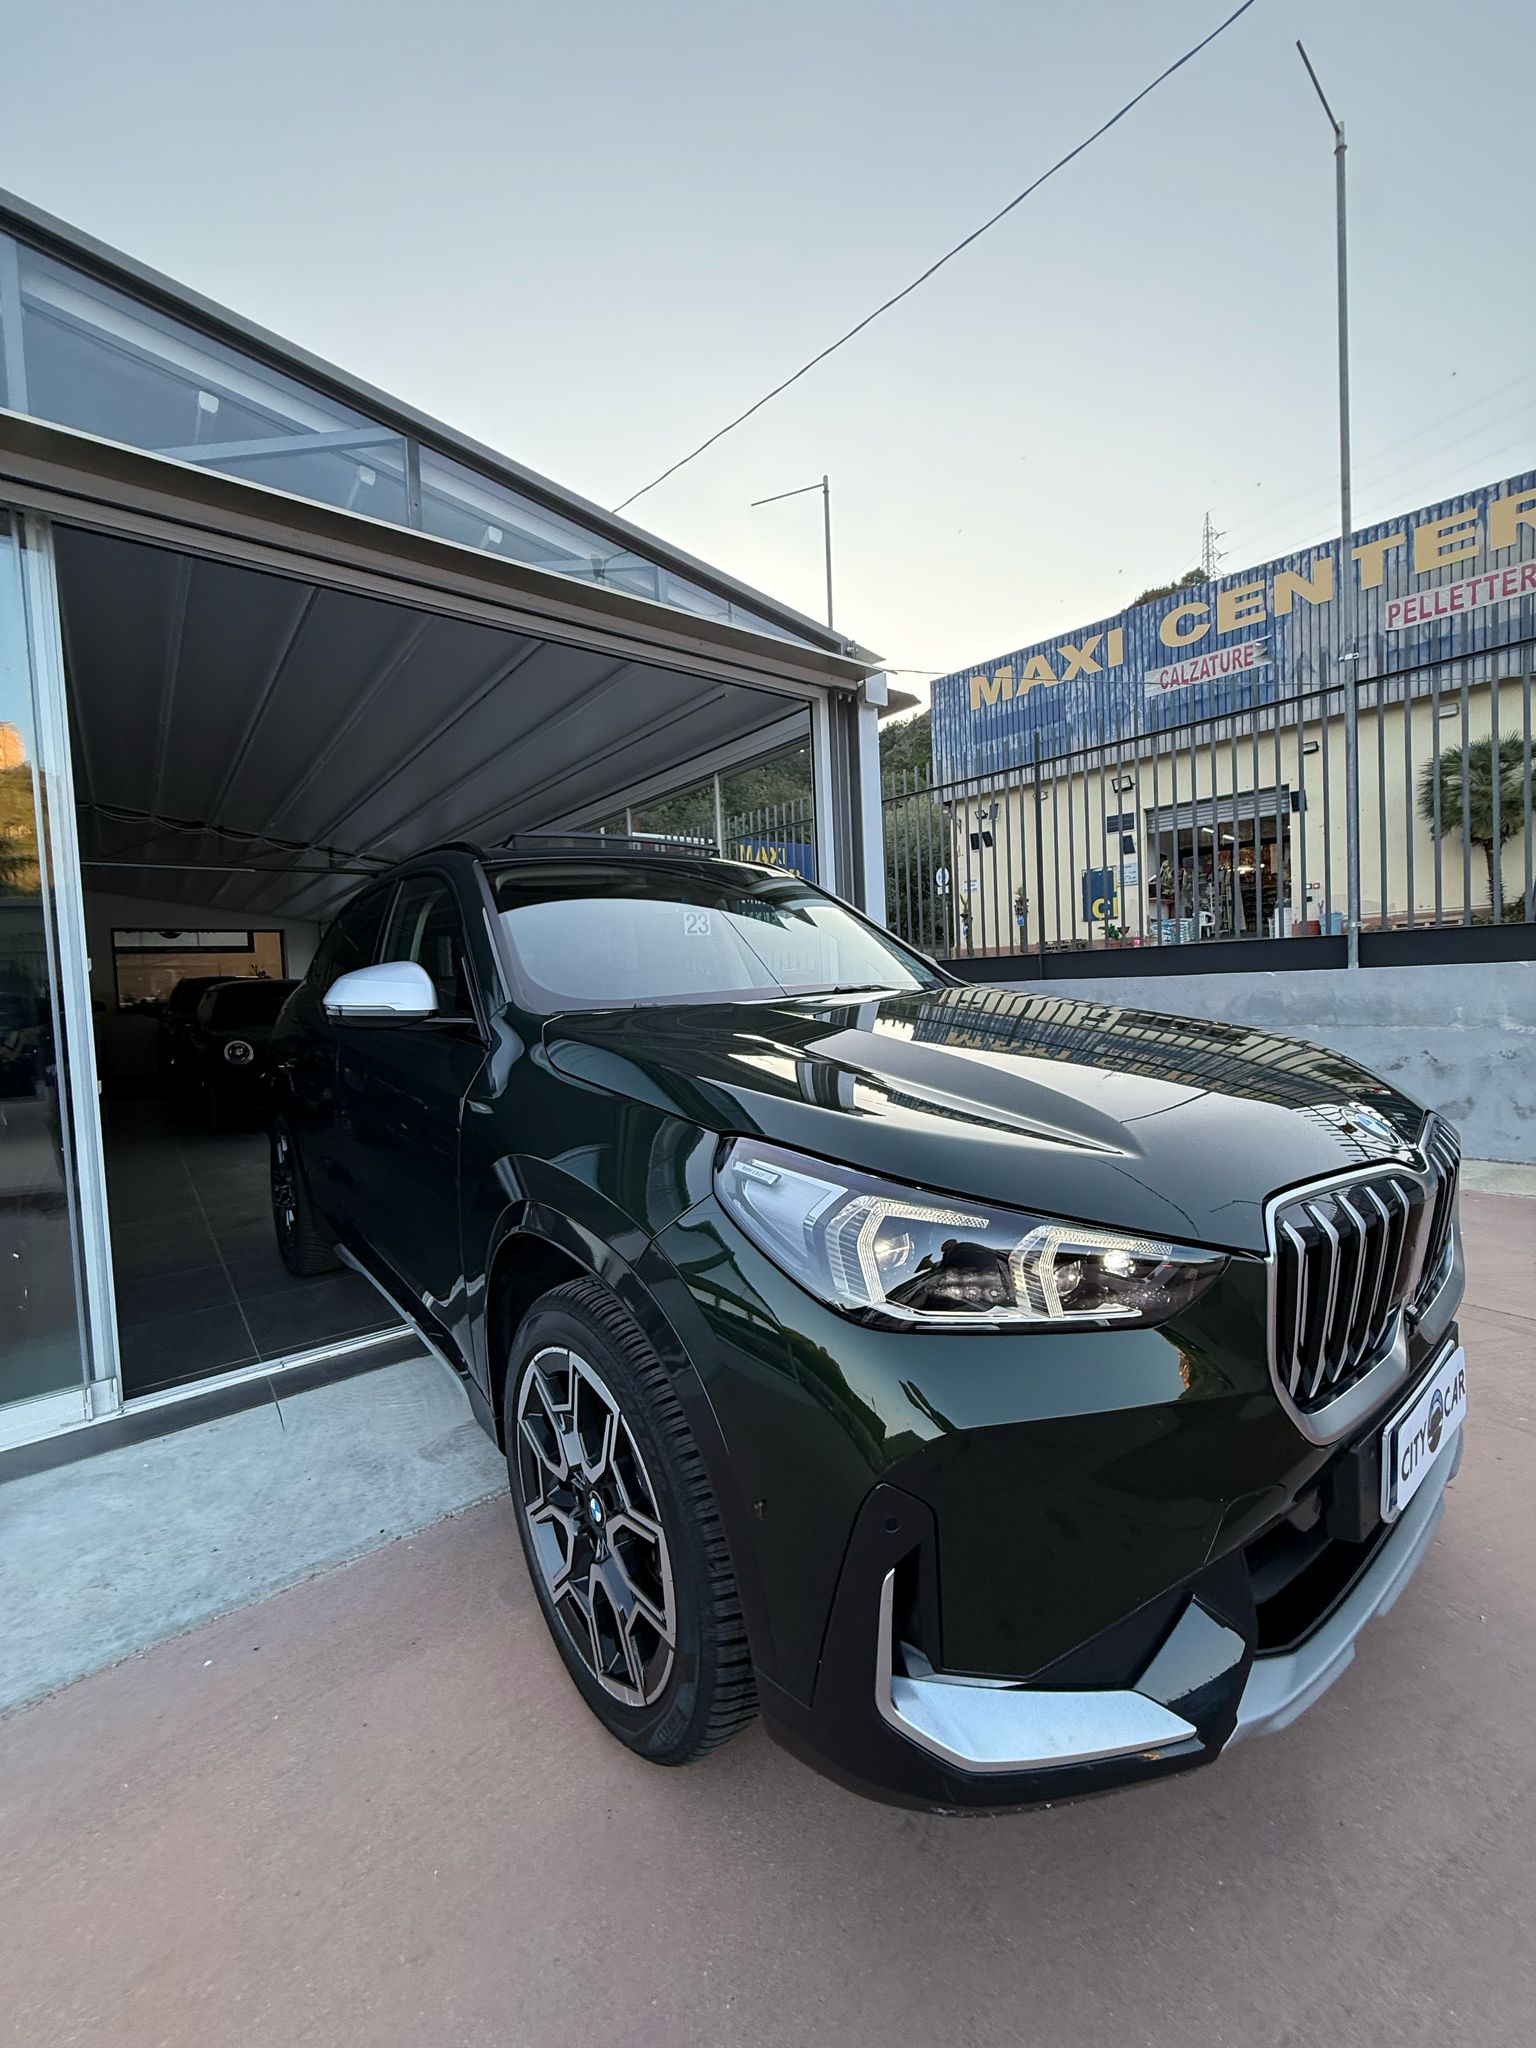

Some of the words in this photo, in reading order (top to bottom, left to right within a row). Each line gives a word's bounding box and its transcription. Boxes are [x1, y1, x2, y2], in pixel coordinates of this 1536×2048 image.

[969, 626, 1124, 711] MAXI
[1160, 644, 1254, 690] CALZATURE
[686, 913, 709, 934] 23
[1401, 1420, 1428, 1482] CITY
[1443, 1368, 1466, 1418] CAR
